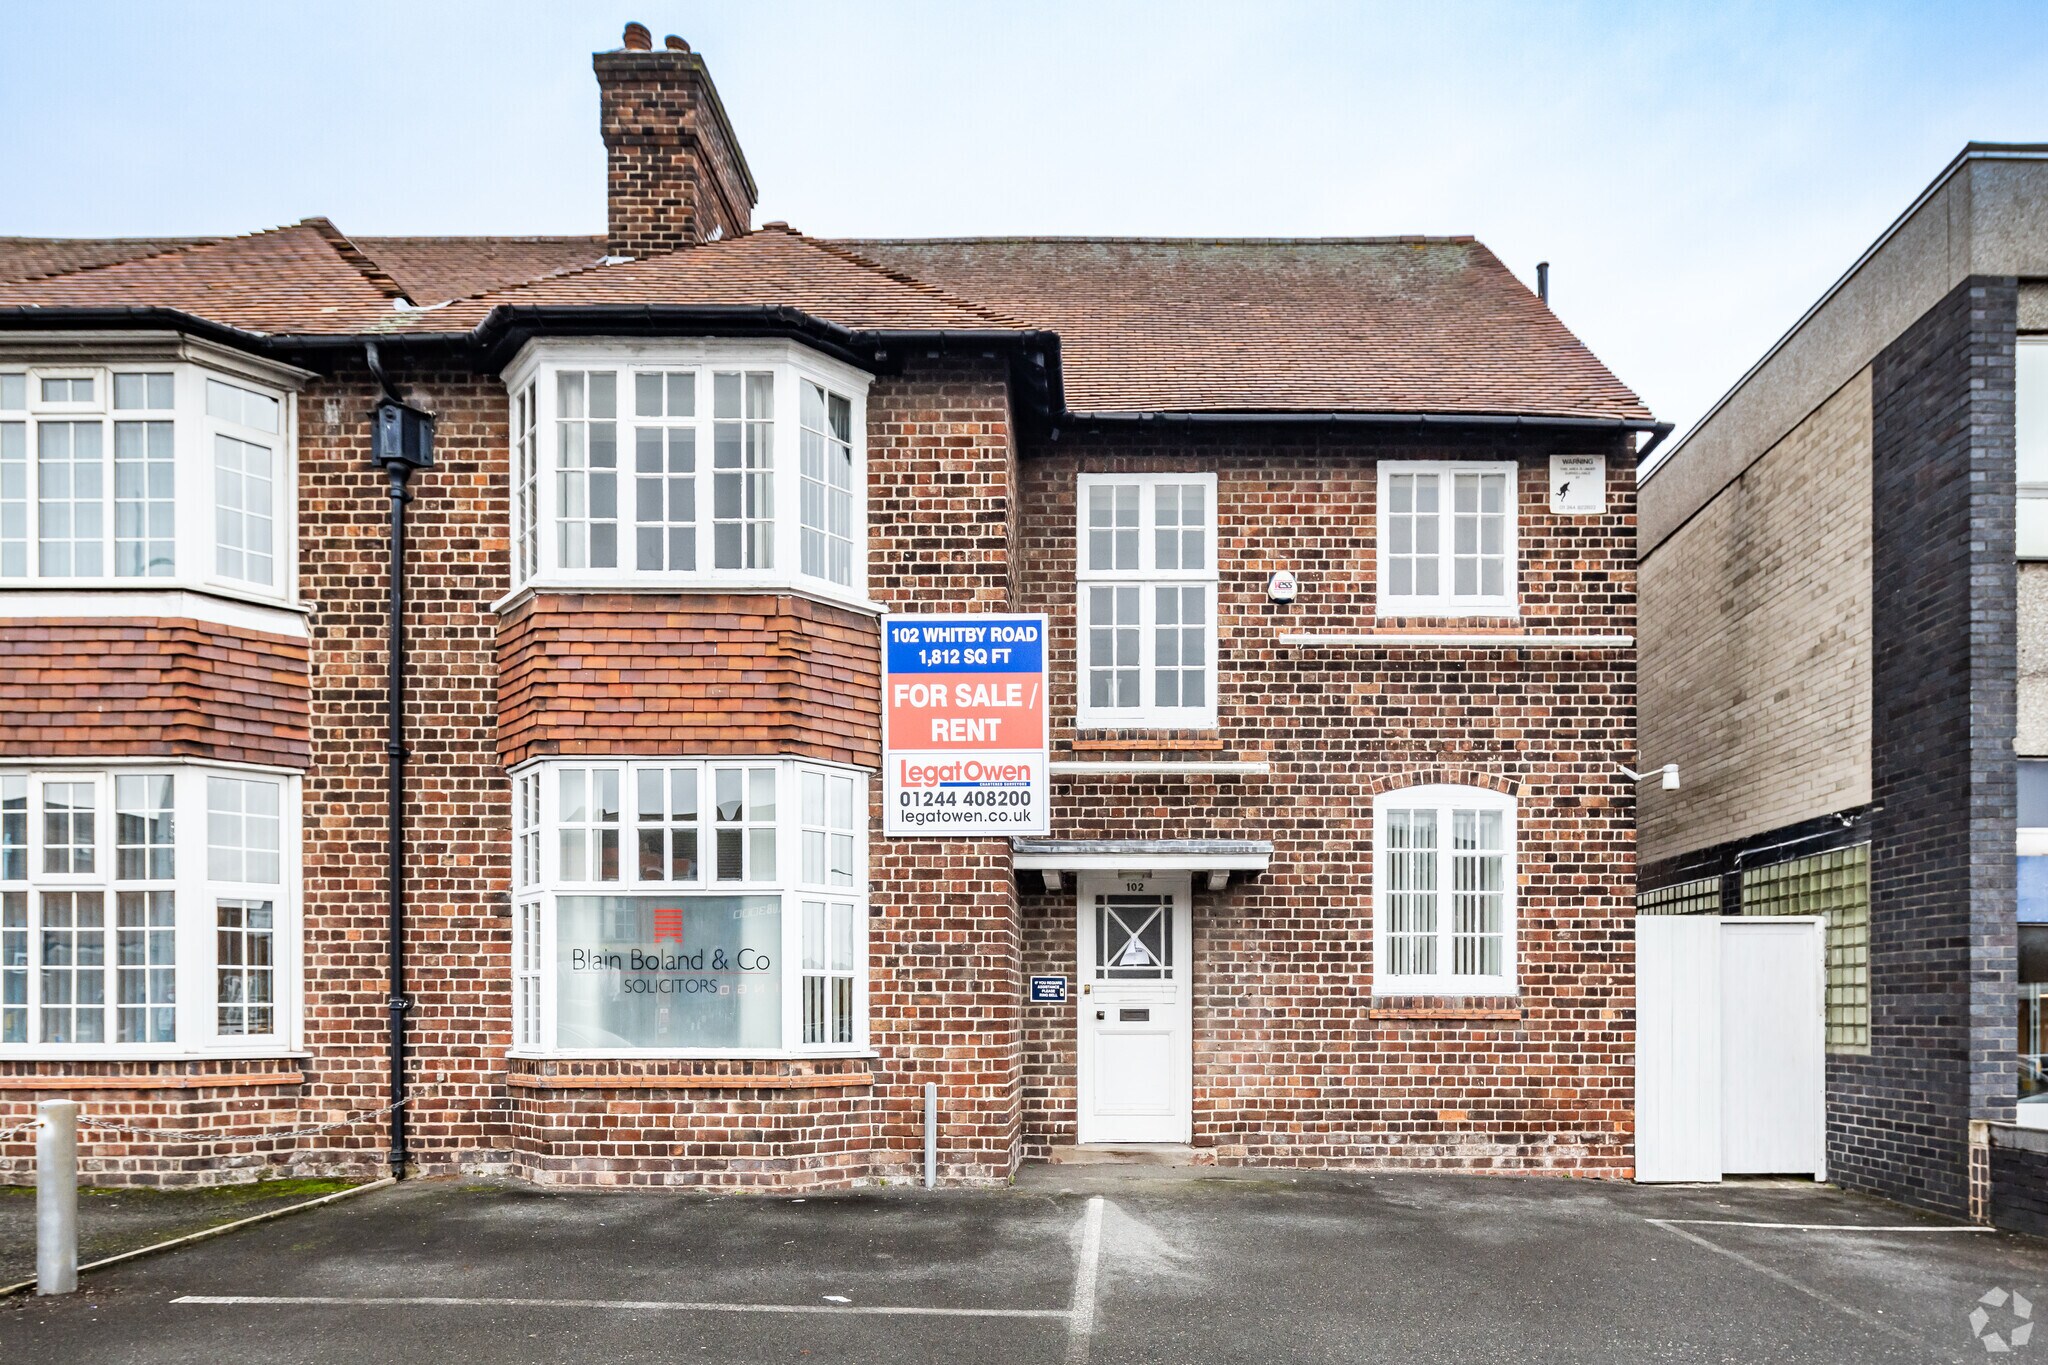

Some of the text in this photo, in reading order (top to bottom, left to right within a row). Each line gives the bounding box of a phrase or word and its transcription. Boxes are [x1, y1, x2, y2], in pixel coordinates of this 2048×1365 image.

[892, 626, 1038, 643] 102 WHITBY ROAD
[919, 648, 1012, 667] 1,812 SQ FT
[894, 682, 1038, 710] FOR SALE /
[931, 718, 1001, 742] RENT
[900, 790, 1031, 807] 01244 408200
[901, 809, 1031, 826] legatowen.co.uk
[1126, 883, 1144, 892] 102
[573, 948, 771, 970] Blain Boland & Co
[624, 978, 718, 994] SOLICITORS
